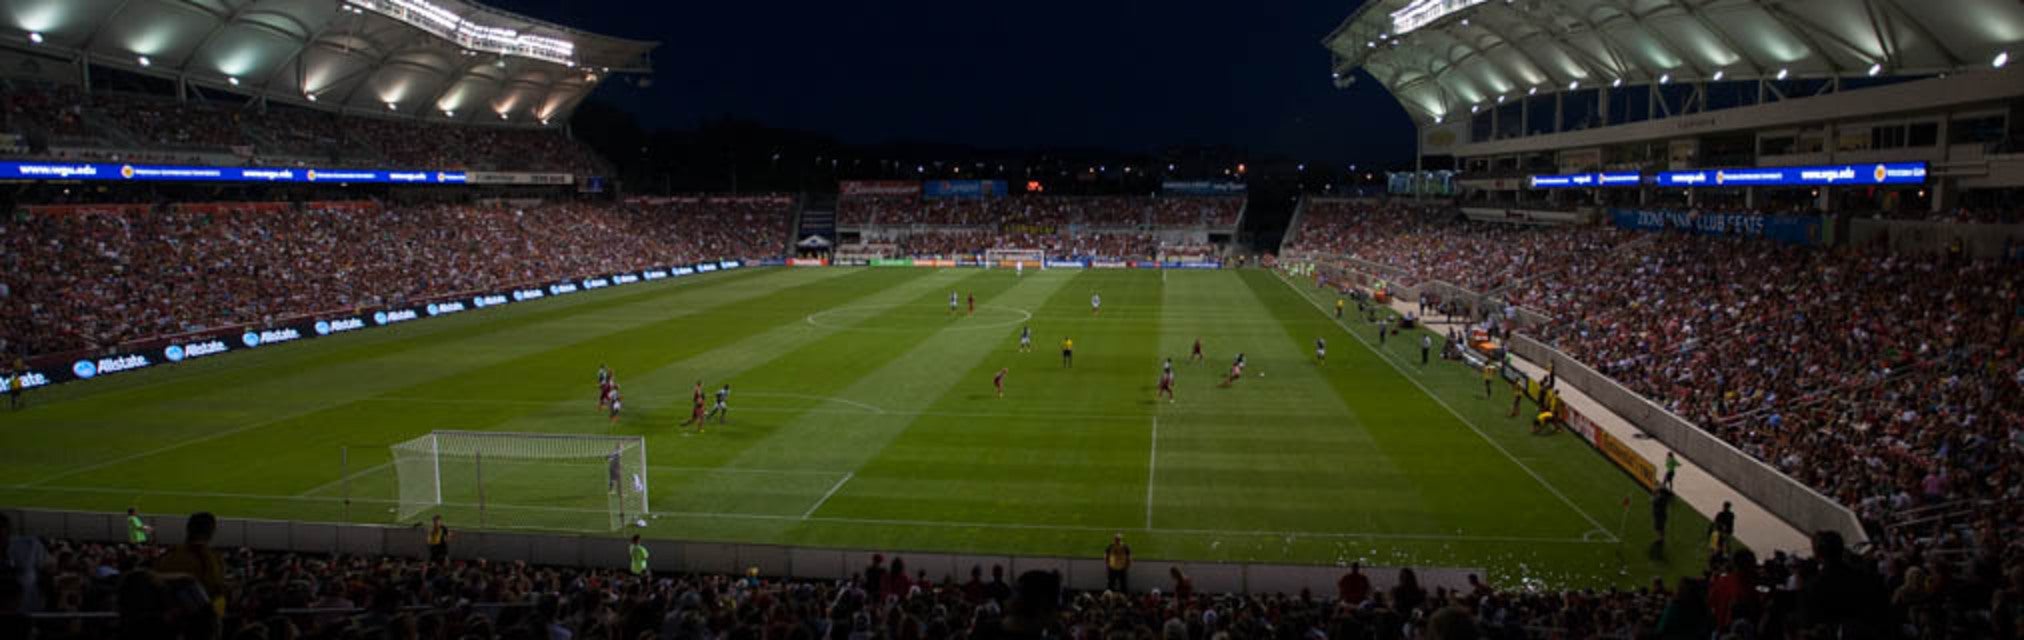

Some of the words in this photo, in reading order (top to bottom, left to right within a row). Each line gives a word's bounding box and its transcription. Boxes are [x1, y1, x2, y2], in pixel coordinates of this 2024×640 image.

[19, 164, 97, 177] www.wgu.edu
[1696, 212, 1725, 232] CLUB
[184, 340, 229, 357] Allstate
[97, 353, 148, 374] Allstate
